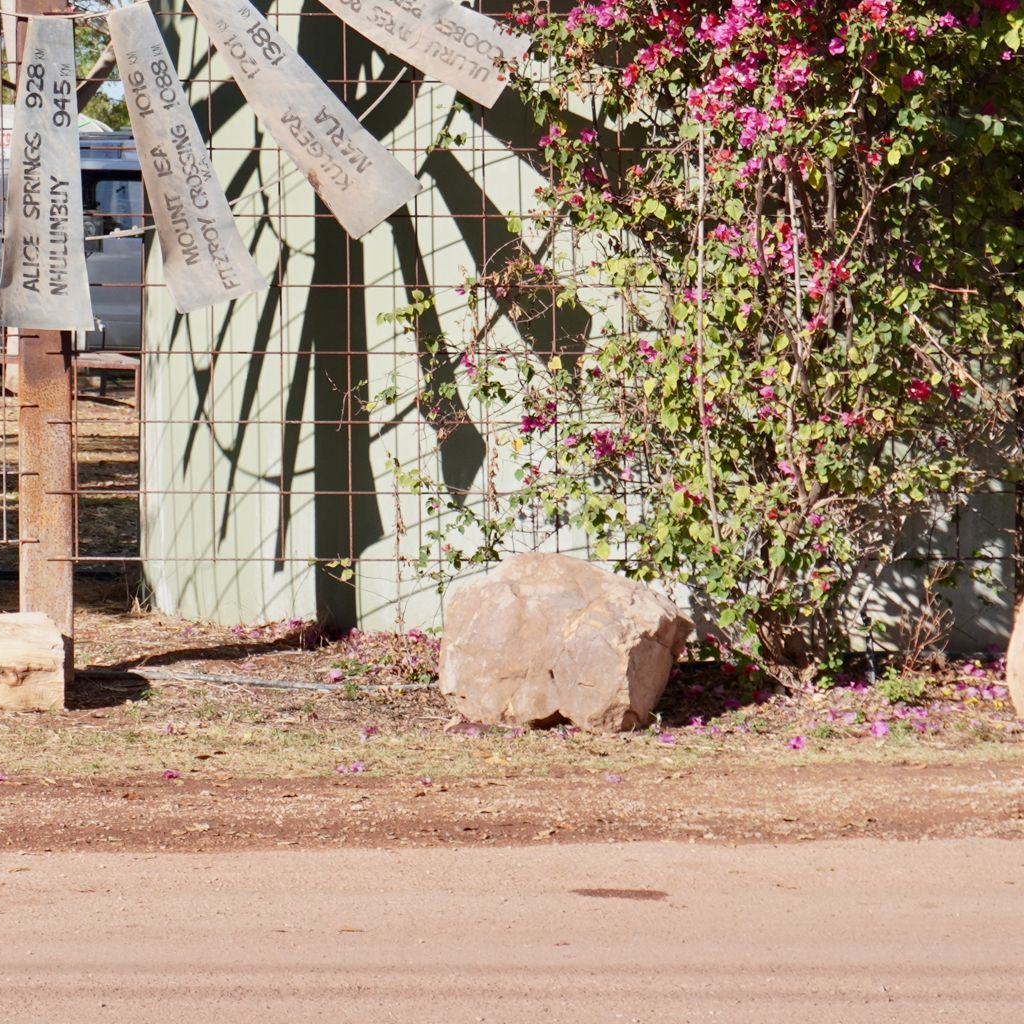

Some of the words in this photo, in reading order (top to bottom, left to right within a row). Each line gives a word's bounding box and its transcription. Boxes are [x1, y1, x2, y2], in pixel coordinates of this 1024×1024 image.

[34, 47, 45, 59] KM
[125, 49, 139, 65] KM
[150, 43, 163, 57] KM
[221, 33, 264, 81] 1201
[245, 20, 287, 67] 1381
[424, 35, 492, 86] ULURU
[25, 62, 44, 109] 928
[59, 63, 71, 76] KM
[125, 68, 155, 118] 1016
[149, 57, 179, 111] 1088
[52, 79, 72, 128] 945
[148, 143, 173, 178] ISA
[277, 103, 354, 195] KULGERA
[310, 102, 373, 176] MARLA
[20, 131, 42, 219] SPRINGS
[168, 122, 211, 211] CROSSING
[46, 175, 71, 295] NHULUNBUY
[163, 190, 202, 267] MOUNT
[21, 235, 42, 293] ALICE
